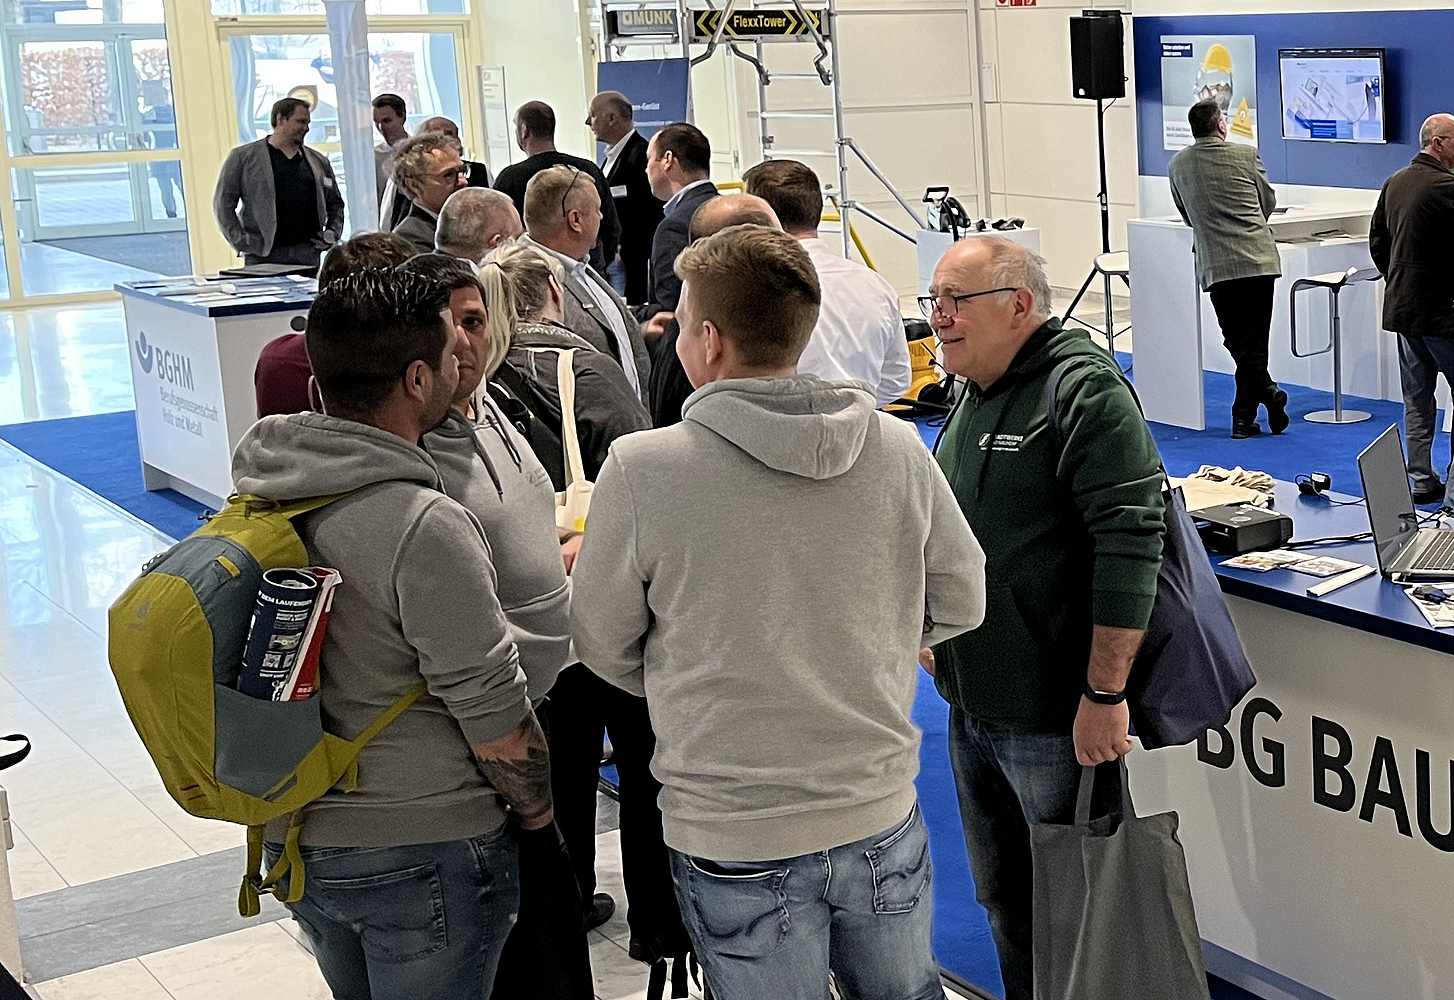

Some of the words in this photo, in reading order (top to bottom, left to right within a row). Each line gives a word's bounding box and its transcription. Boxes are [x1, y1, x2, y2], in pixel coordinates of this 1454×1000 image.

[632, 10, 673, 26] MUNK
[733, 15, 787, 28] FlexxTower
[155, 347, 195, 392] BGHM
[1197, 697, 1286, 788] BG
